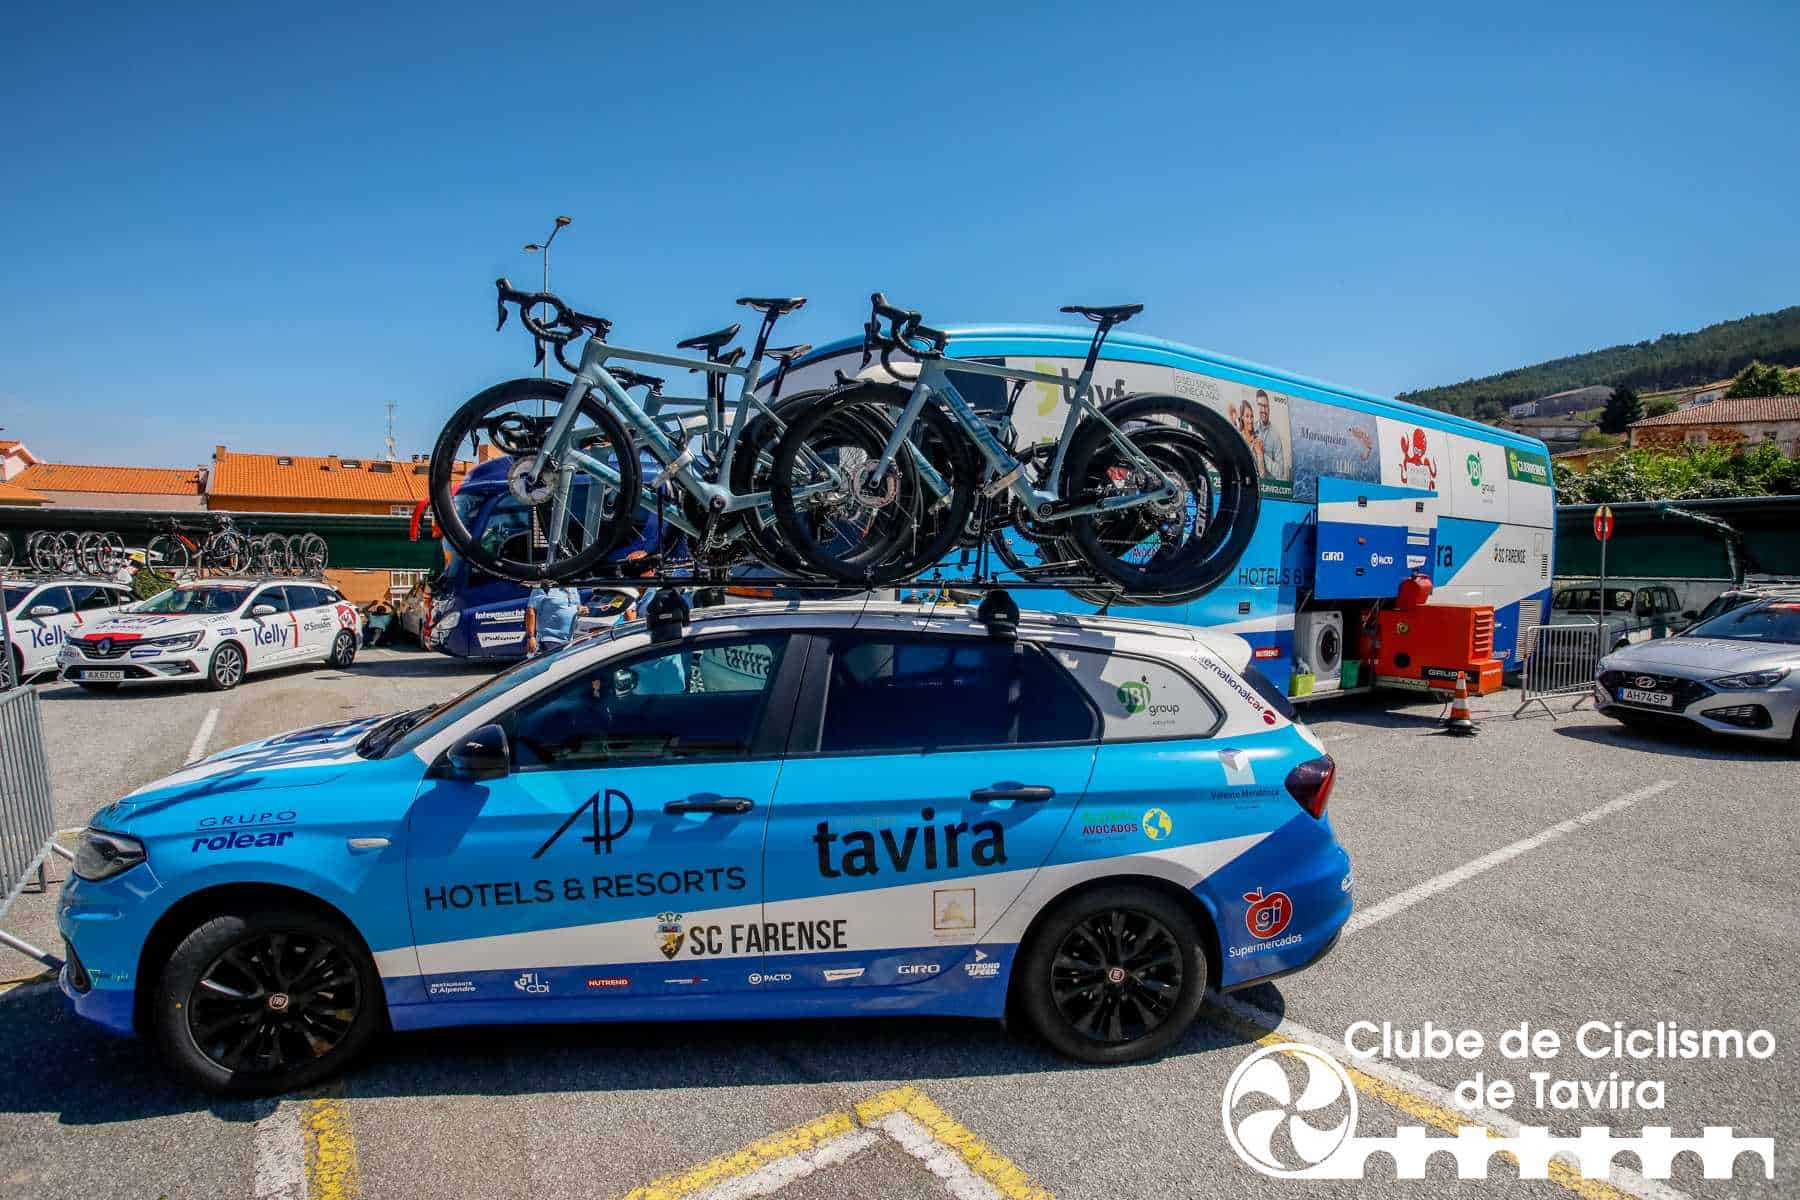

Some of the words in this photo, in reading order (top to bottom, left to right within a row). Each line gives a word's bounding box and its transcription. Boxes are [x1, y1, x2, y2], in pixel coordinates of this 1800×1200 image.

[1322, 552, 1344, 561] GIRO
[1239, 568, 1290, 585] HOTELS
[32, 625, 66, 648] Kell
[253, 624, 288, 647] Kelly
[1428, 669, 1472, 680] GRUPL
[1149, 704, 1180, 716] group
[200, 811, 296, 826] GRUPO
[1082, 822, 1138, 834] AVOCADOS
[192, 831, 294, 853] rolear
[813, 808, 1008, 878] tavira
[425, 880, 553, 911] HOTELS
[563, 877, 585, 900] &
[593, 866, 746, 899] RESORTS
[689, 925, 722, 955] SC
[731, 920, 847, 953] FARENSE
[1229, 933, 1302, 958] Supermercados
[898, 964, 940, 974] GIRO
[764, 974, 791, 982] PACTO
[440, 985, 475, 993] Alpendre
